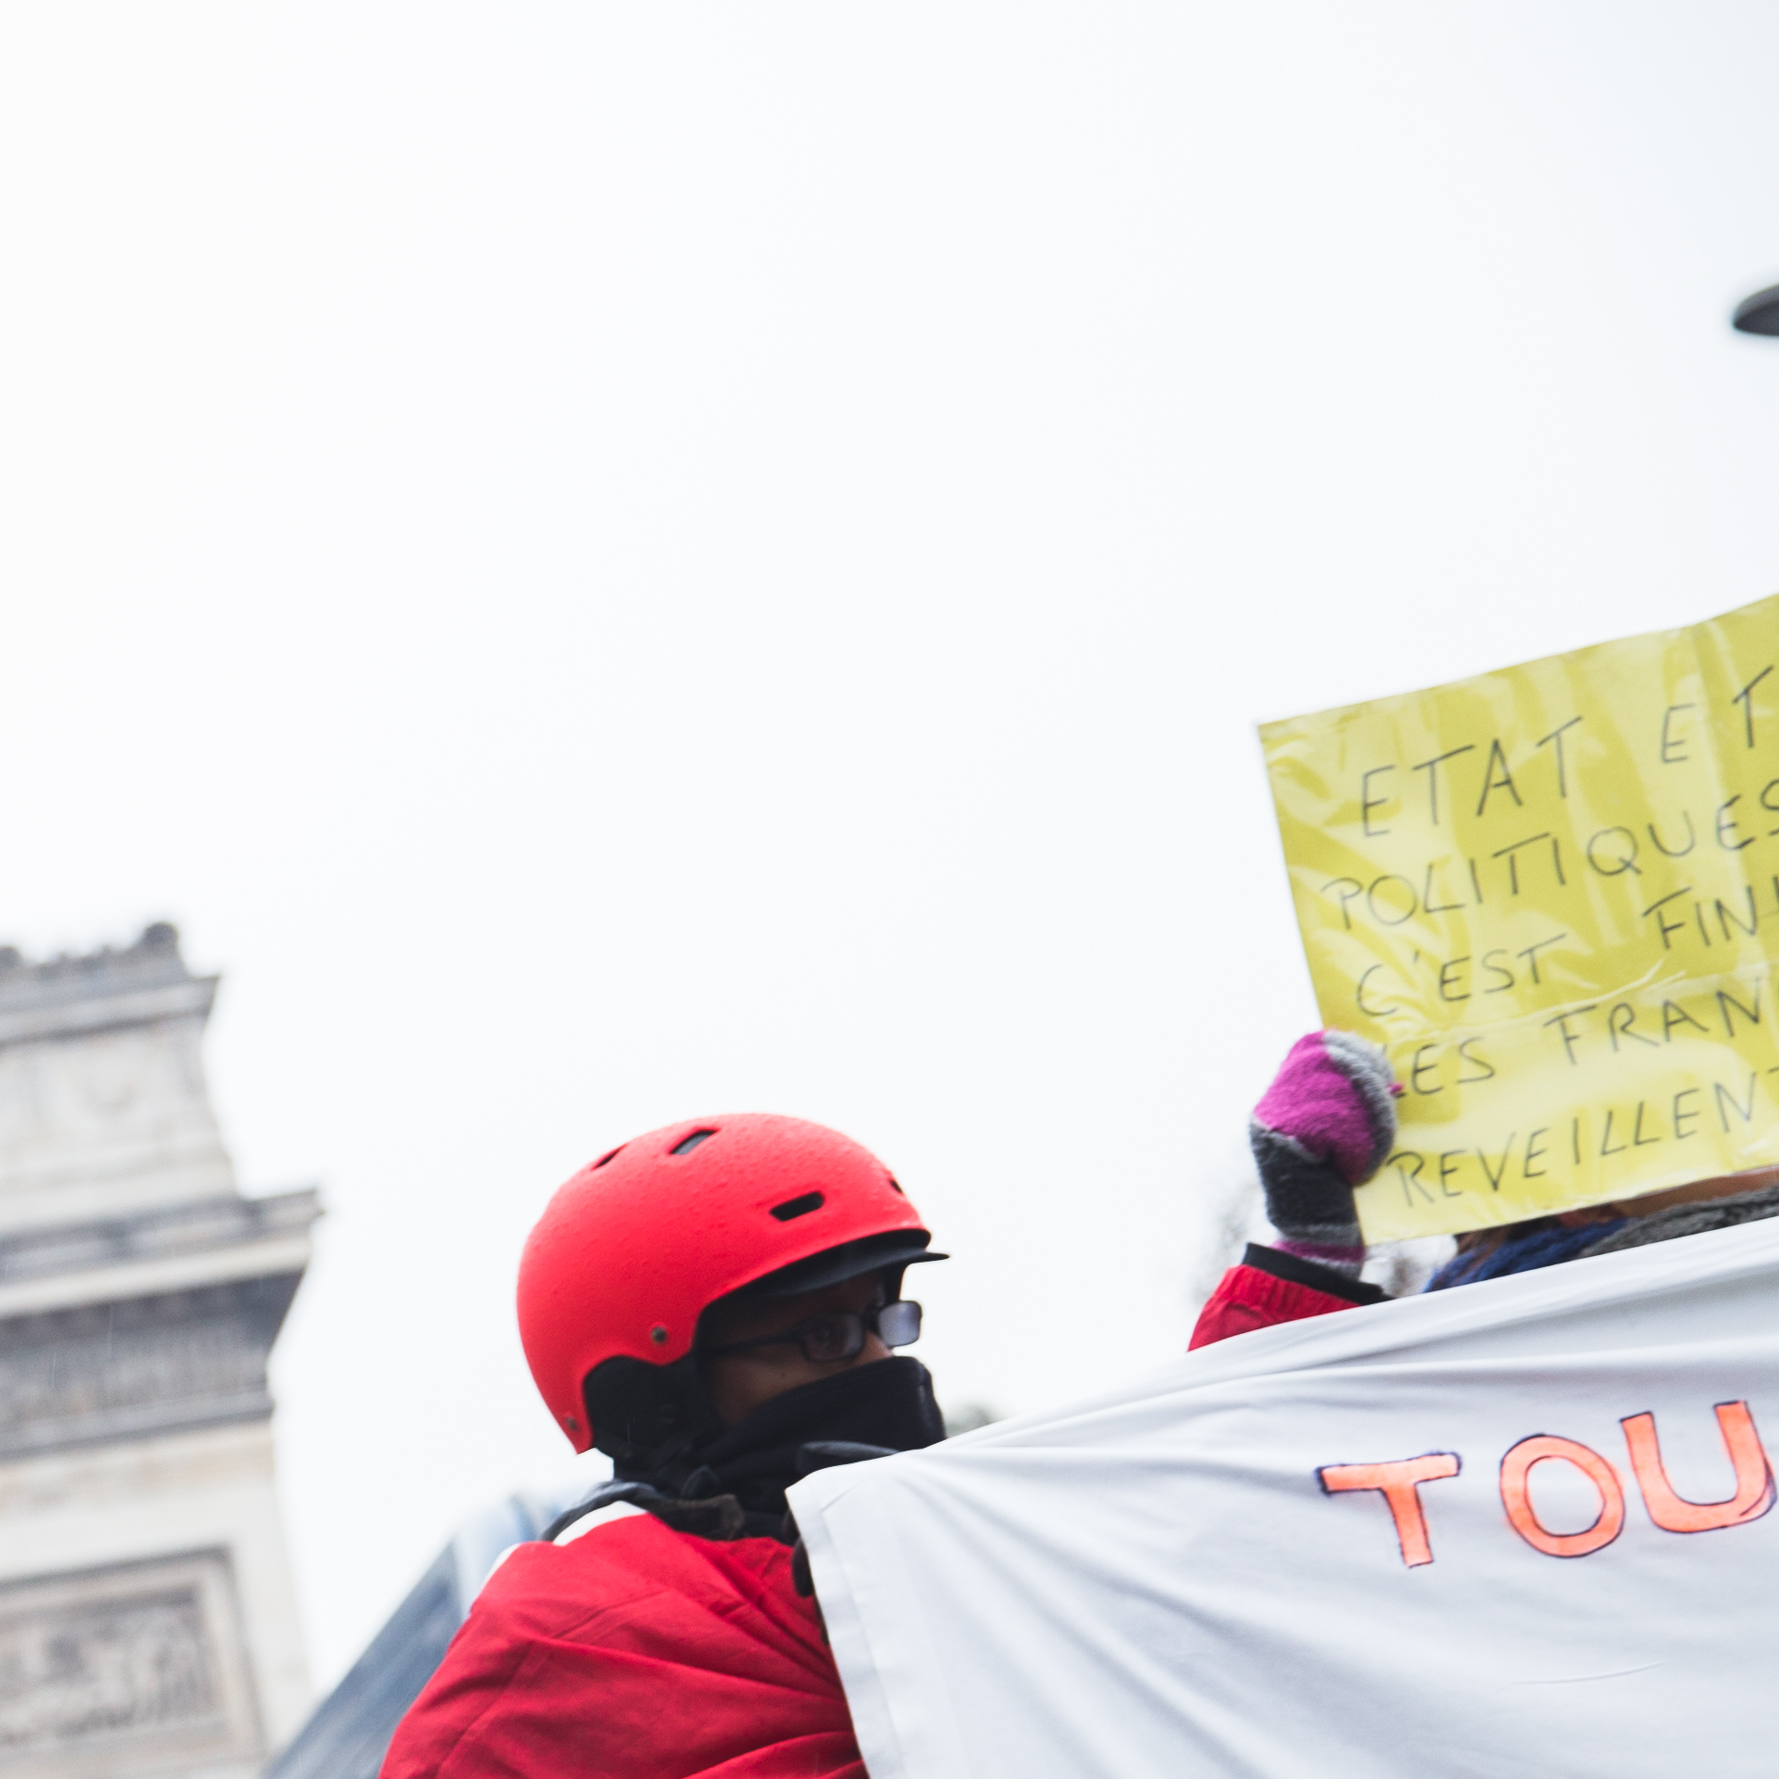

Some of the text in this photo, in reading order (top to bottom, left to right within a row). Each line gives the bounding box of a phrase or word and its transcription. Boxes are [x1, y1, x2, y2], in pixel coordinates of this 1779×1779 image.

[1360, 664, 1775, 837] ETAT ET
[1356, 932, 1568, 1017] C'EST
[1383, 974, 1779, 1099] ES FRAN
[1386, 1066, 1779, 1208] REVEILLEN
[1316, 1399, 1777, 1568] TOU
